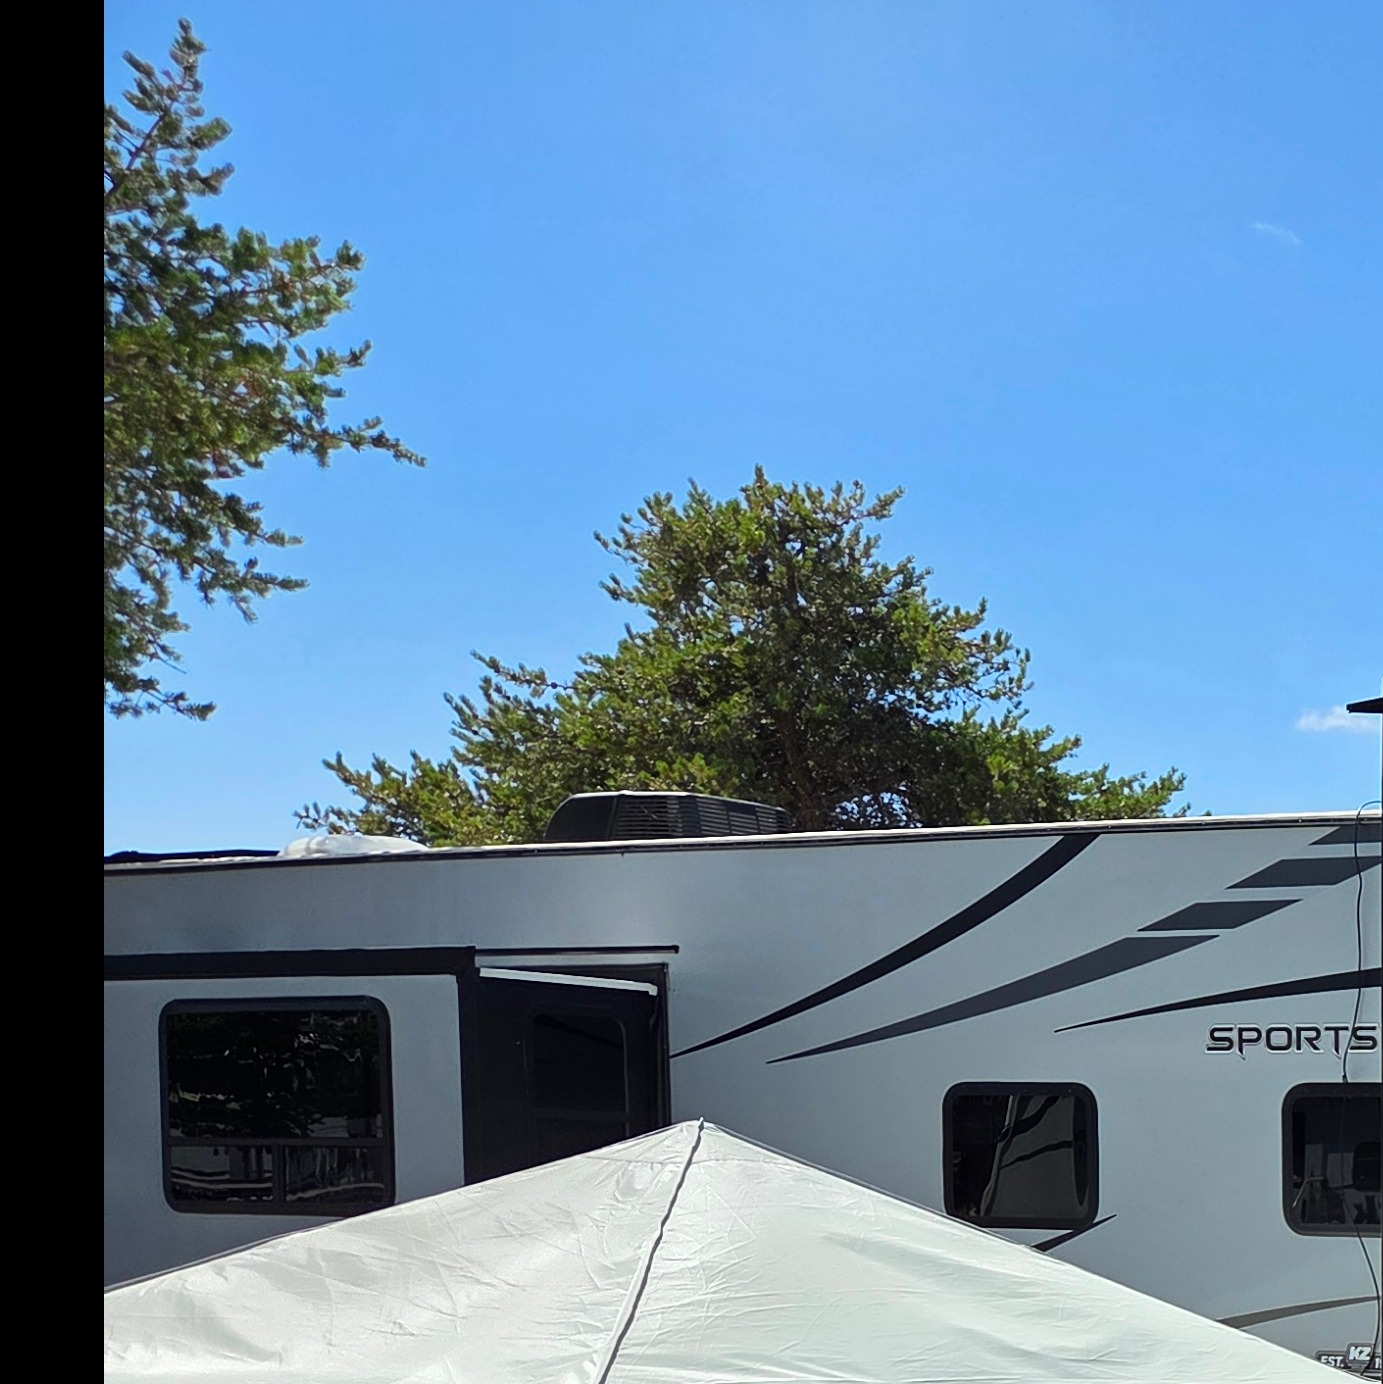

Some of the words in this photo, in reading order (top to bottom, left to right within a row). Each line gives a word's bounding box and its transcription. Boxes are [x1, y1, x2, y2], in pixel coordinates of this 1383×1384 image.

[1206, 1024, 1379, 1060] SPORTS
[1321, 1356, 1345, 1368] EST.
[1348, 1346, 1372, 1361] KZ
